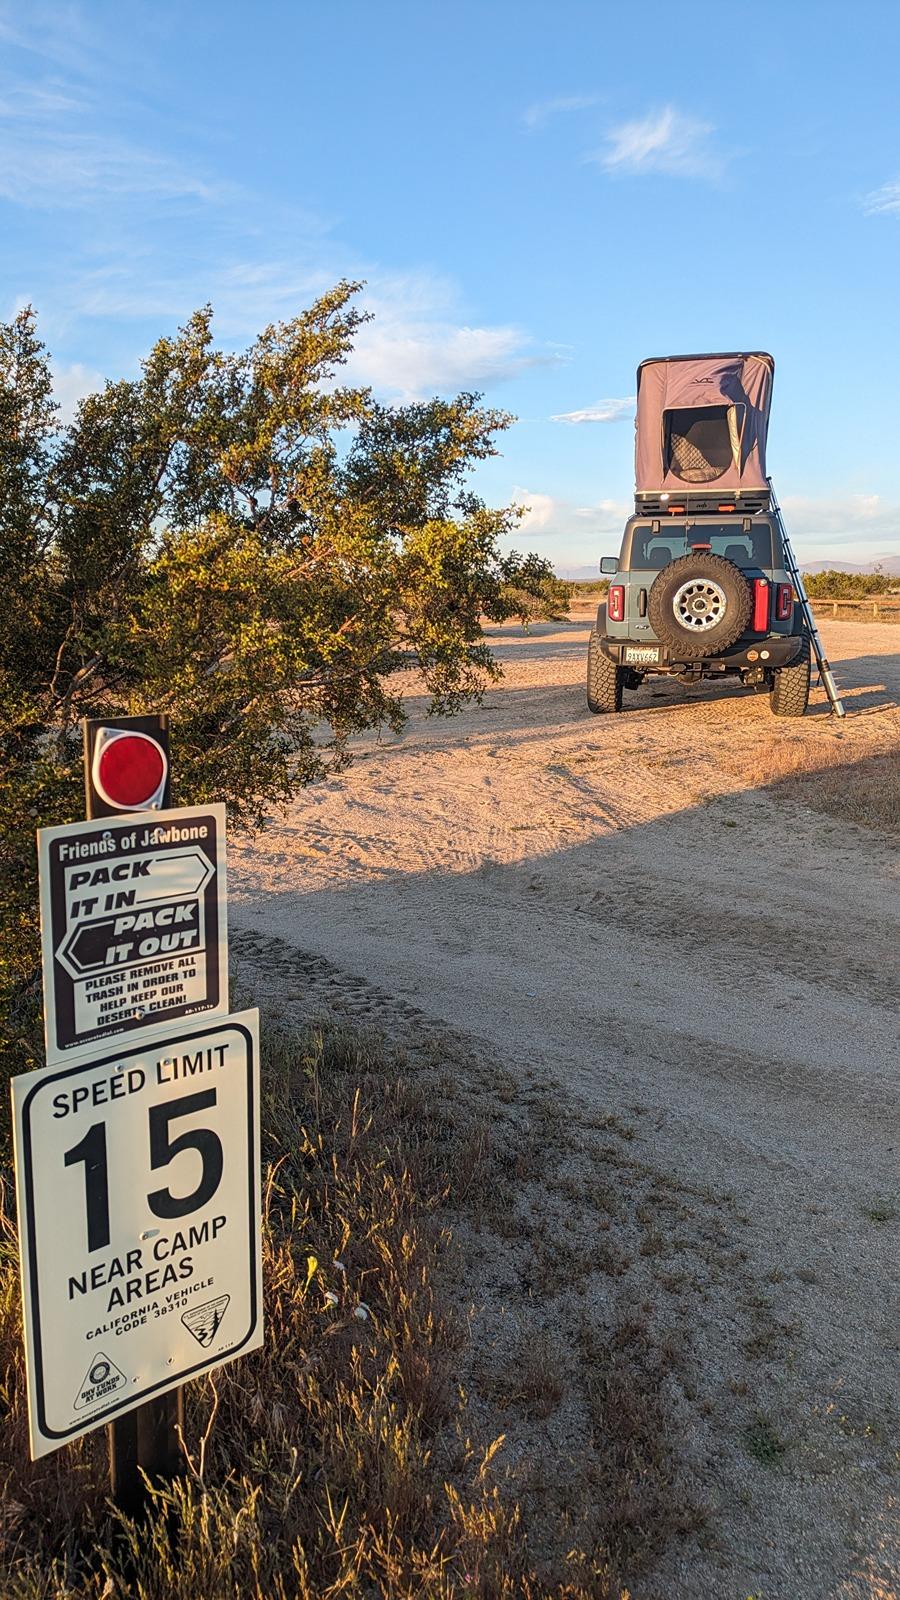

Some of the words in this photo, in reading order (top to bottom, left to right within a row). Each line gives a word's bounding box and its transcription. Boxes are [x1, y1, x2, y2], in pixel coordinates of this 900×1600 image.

[59, 837, 116, 861] Friends
[121, 832, 137, 849] of
[141, 825, 208, 847] Jawbone
[69, 859, 153, 891] PACK
[70, 897, 98, 919] IT
[104, 889, 136, 912] IN
[114, 903, 197, 936] PACK
[105, 943, 134, 965] IT
[138, 929, 198, 957] OUT
[85, 972, 126, 991] PLEASE
[130, 960, 174, 980] REMOVE
[178, 957, 196, 968] ALL
[86, 986, 123, 1003] TRASH
[127, 982, 139, 993] IN
[143, 973, 179, 988] ORDER
[183, 969, 196, 979] TO
[97, 1005, 145, 1026] DESERTS
[149, 995, 187, 1011] CLEAN!
[100, 998, 127, 1012] HELP
[131, 990, 157, 1004] KEEP
[161, 984, 184, 996] OUR
[52, 1068, 146, 1119] SPEED
[156, 1044, 229, 1085] LIMIT
[64, 1087, 224, 1253] 15
[68, 1248, 143, 1300] NEAR
[153, 1215, 227, 1261] CAMP
[107, 1257, 194, 1313] AREAS
[86, 1302, 159, 1340] CALIFORNIA
[165, 1277, 214, 1303] VEHICLE
[115, 1315, 148, 1336] CODE
[154, 1298, 188, 1318] 38310
[86, 1394, 95, 1403] AT
[96, 1383, 117, 1397] WORK
[96, 1374, 120, 1391] FUNDS
